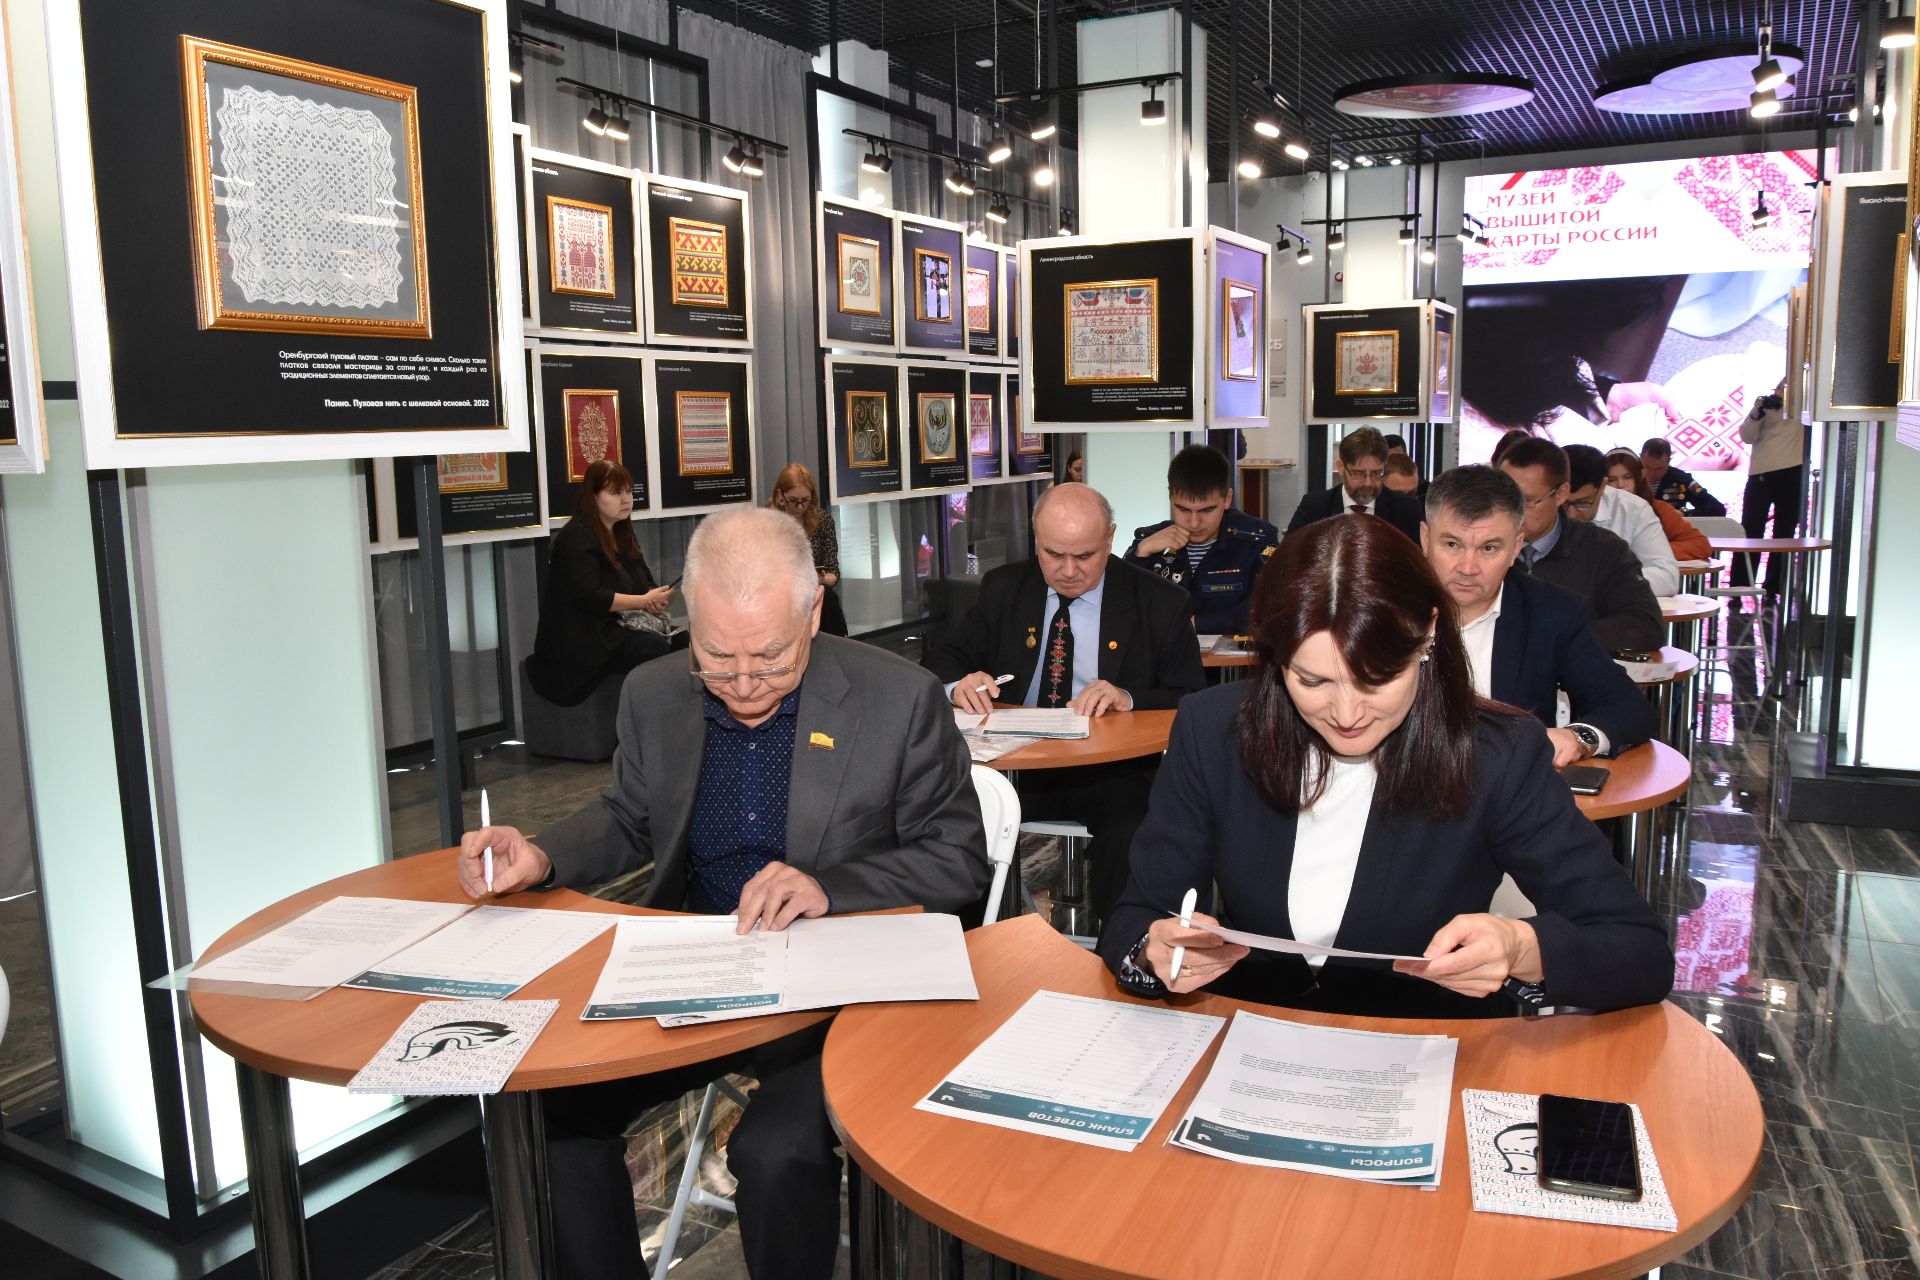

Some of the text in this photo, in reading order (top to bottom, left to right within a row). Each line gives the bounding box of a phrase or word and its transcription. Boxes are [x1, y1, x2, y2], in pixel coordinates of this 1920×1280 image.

[1487, 190, 1555, 208] МУЗЕЙ
[1486, 206, 1600, 228] ВЫШИТОЙ
[1486, 226, 1658, 249] КАРТЫ РОССИИ
[279, 350, 328, 360] Оренбургский
[324, 399, 351, 407] Панно.
[353, 399, 383, 408] Пуховая
[1028, 1111, 1135, 1136] БЛАНК ОТВЕТОВ
[1350, 1157, 1424, 1166] ВОПРОСЫ
